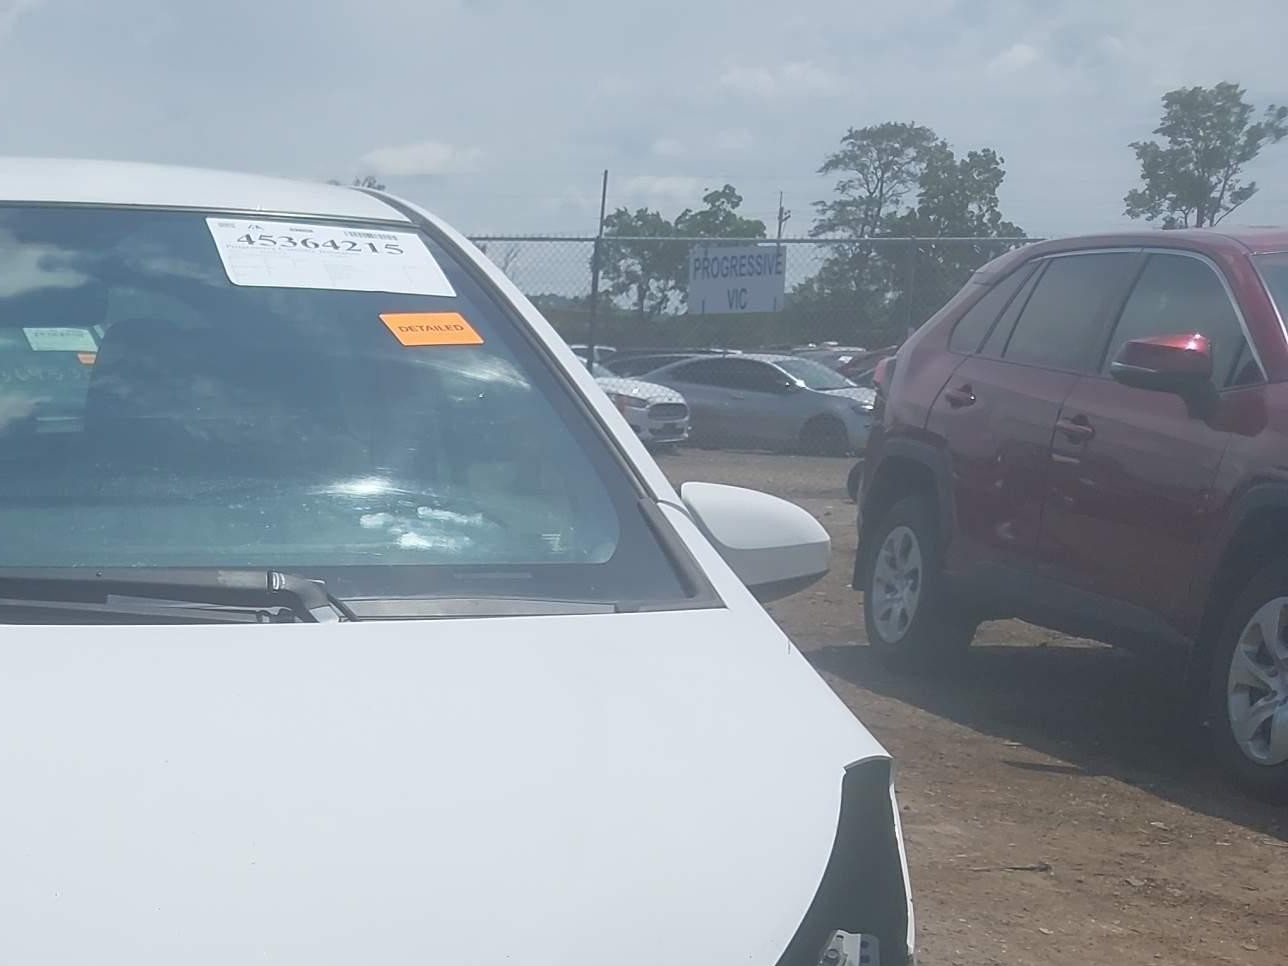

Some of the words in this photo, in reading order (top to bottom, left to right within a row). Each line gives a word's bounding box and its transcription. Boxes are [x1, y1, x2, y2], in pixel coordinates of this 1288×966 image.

[237, 233, 404, 256] 45364215
[693, 253, 783, 279] PROGRESSIVE
[727, 288, 748, 310] VIC
[397, 323, 465, 333] DETAILED
